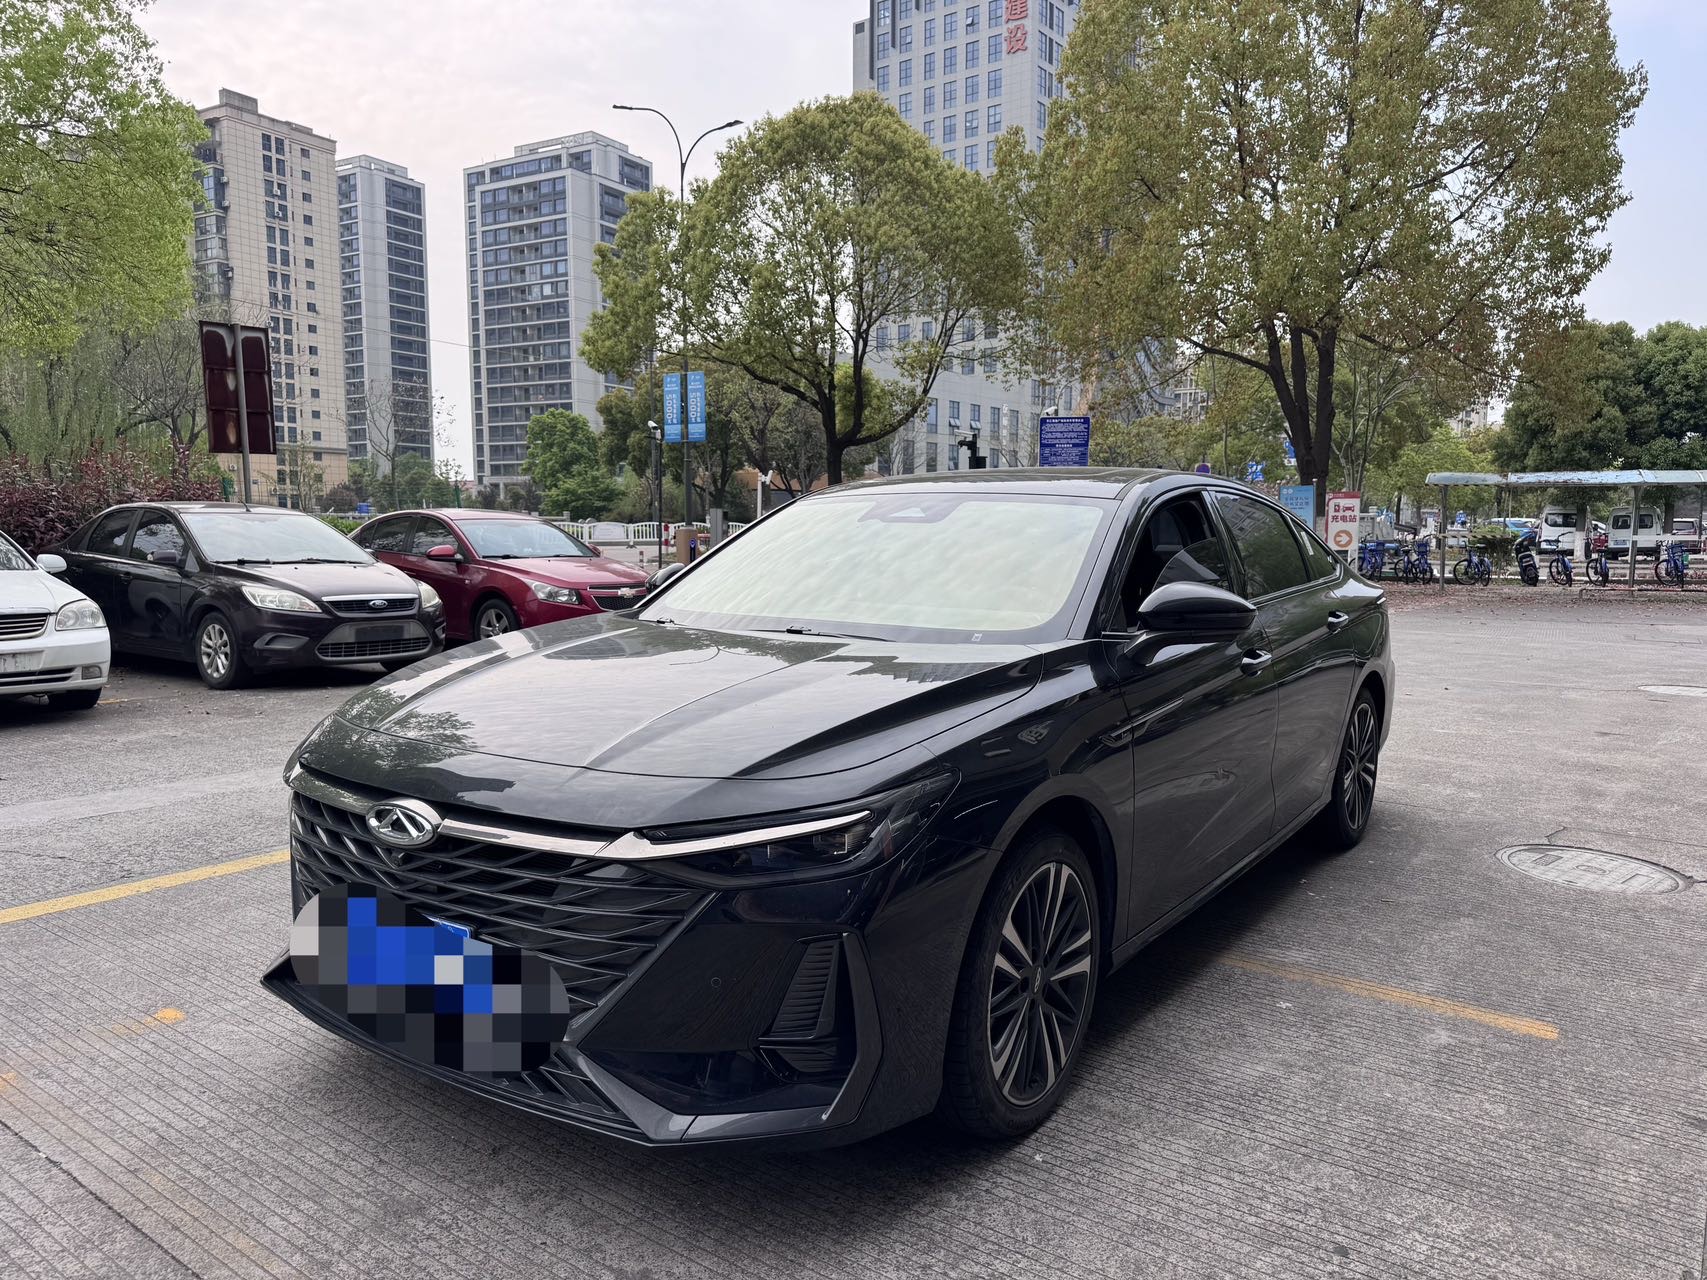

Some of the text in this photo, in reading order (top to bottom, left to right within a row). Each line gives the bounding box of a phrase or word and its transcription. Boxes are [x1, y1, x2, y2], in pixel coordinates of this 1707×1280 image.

[1004, 0, 1028, 54] 建设
[1331, 514, 1357, 523] 充电站
